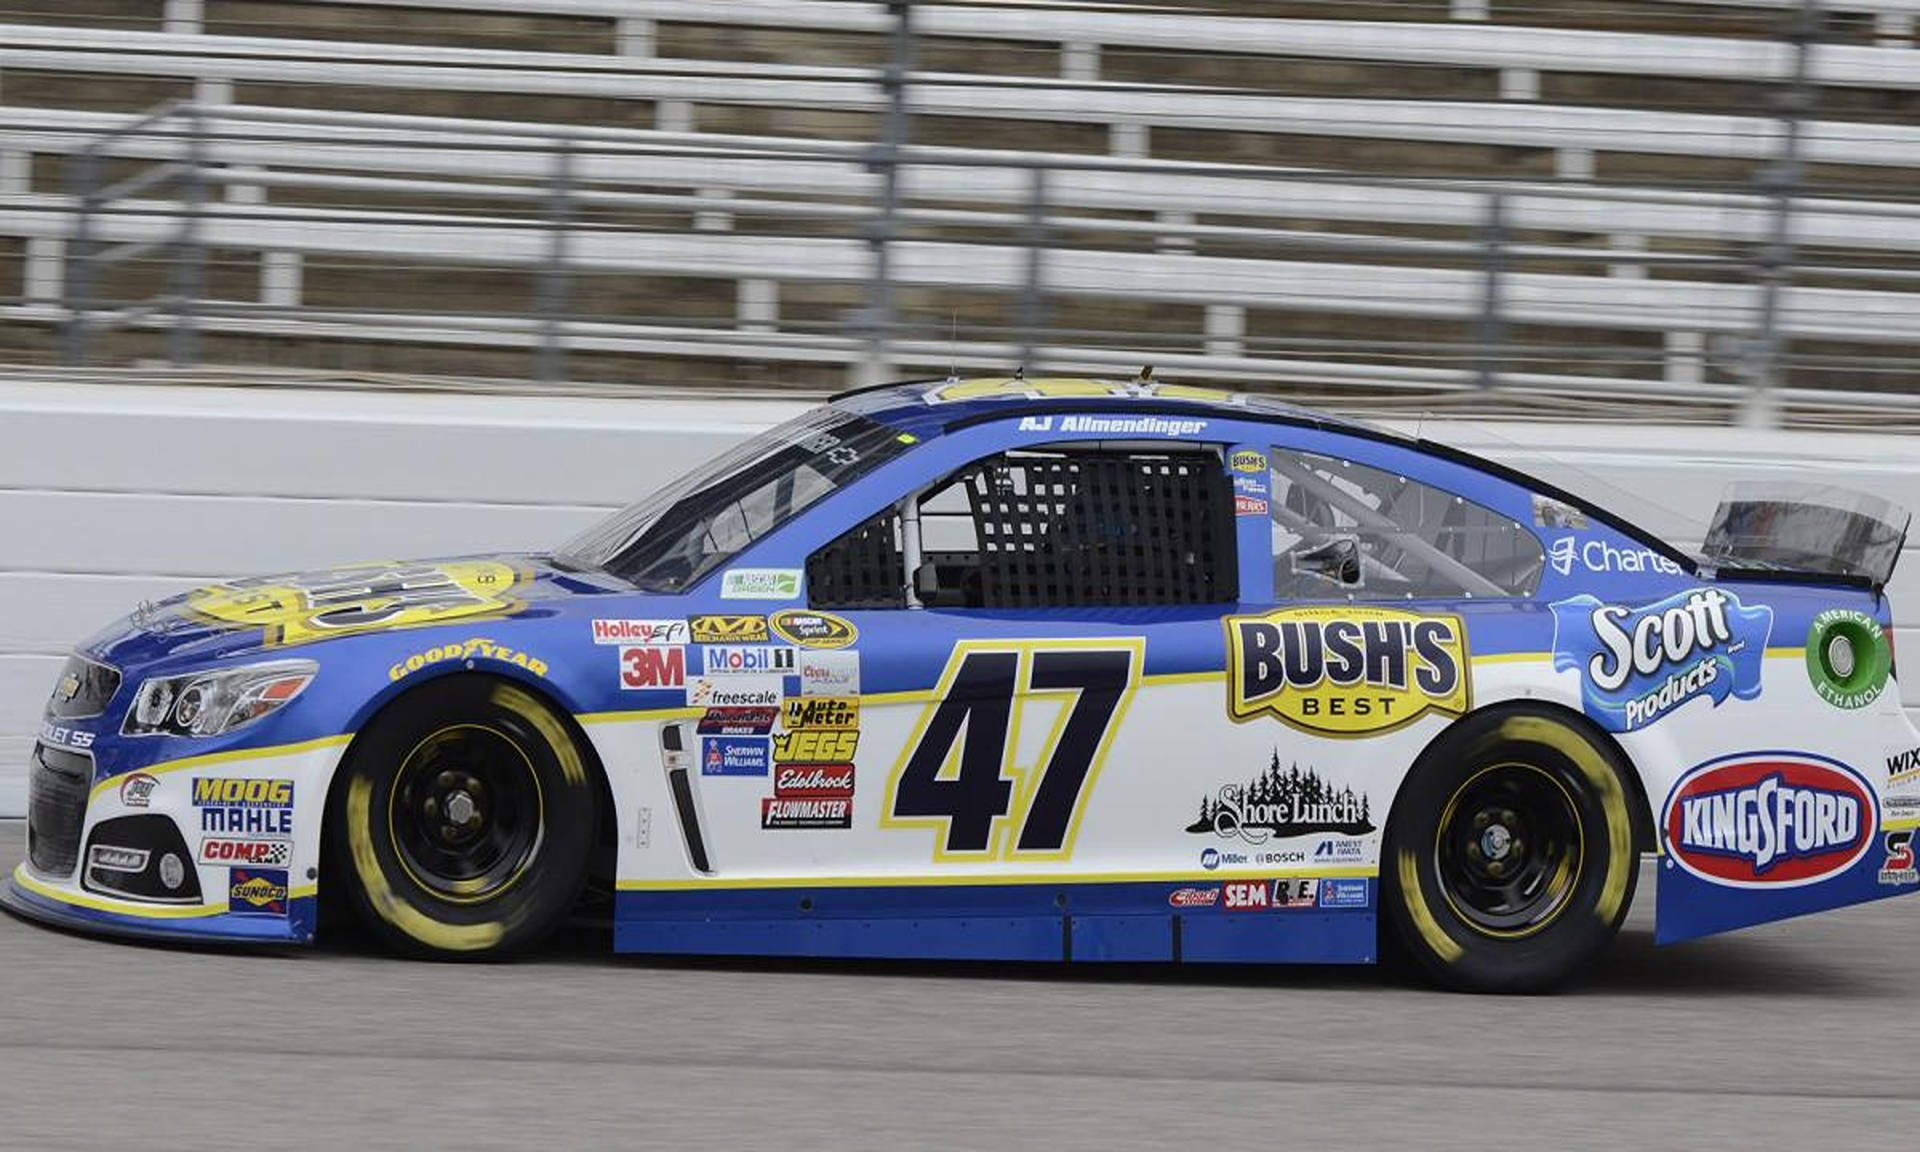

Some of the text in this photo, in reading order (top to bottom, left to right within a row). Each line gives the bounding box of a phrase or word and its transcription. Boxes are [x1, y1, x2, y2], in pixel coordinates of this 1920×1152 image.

[1018, 416, 1207, 436] AJ Allmendinger
[1232, 455, 1266, 469] BUSH'S
[594, 621, 685, 642] Holley EFI
[1813, 609, 1882, 640] AMERICAN
[1589, 590, 1729, 690] Scott
[388, 637, 549, 682] GOODYEAR
[622, 648, 684, 687] 3M
[709, 648, 794, 669] Mobil 1
[1239, 620, 1460, 699] BUSH'S
[712, 690, 777, 705] freescale
[1625, 657, 1719, 730] Products
[1817, 681, 1881, 709] ETHANOL
[808, 701, 847, 713] Auto
[1302, 698, 1396, 716] BEST
[801, 712, 855, 727] Meter
[70, 730, 96, 747] SS
[776, 731, 858, 761] JEGS
[890, 648, 1134, 853] 47
[1887, 748, 1920, 775] WIX
[195, 779, 291, 803] MOOG
[777, 768, 853, 790] Edelbrock
[202, 808, 292, 833] MAHLE
[766, 801, 847, 825] FLOWMASTER
[1214, 784, 1358, 845] Shore Lunch
[1682, 777, 1859, 866] KINGSFORD
[204, 841, 270, 859] COMP
[1221, 854, 1247, 863] Miller
[1266, 852, 1304, 863] BOSCH
[232, 886, 284, 898] SUNOCO
[1225, 883, 1267, 907] SEM
